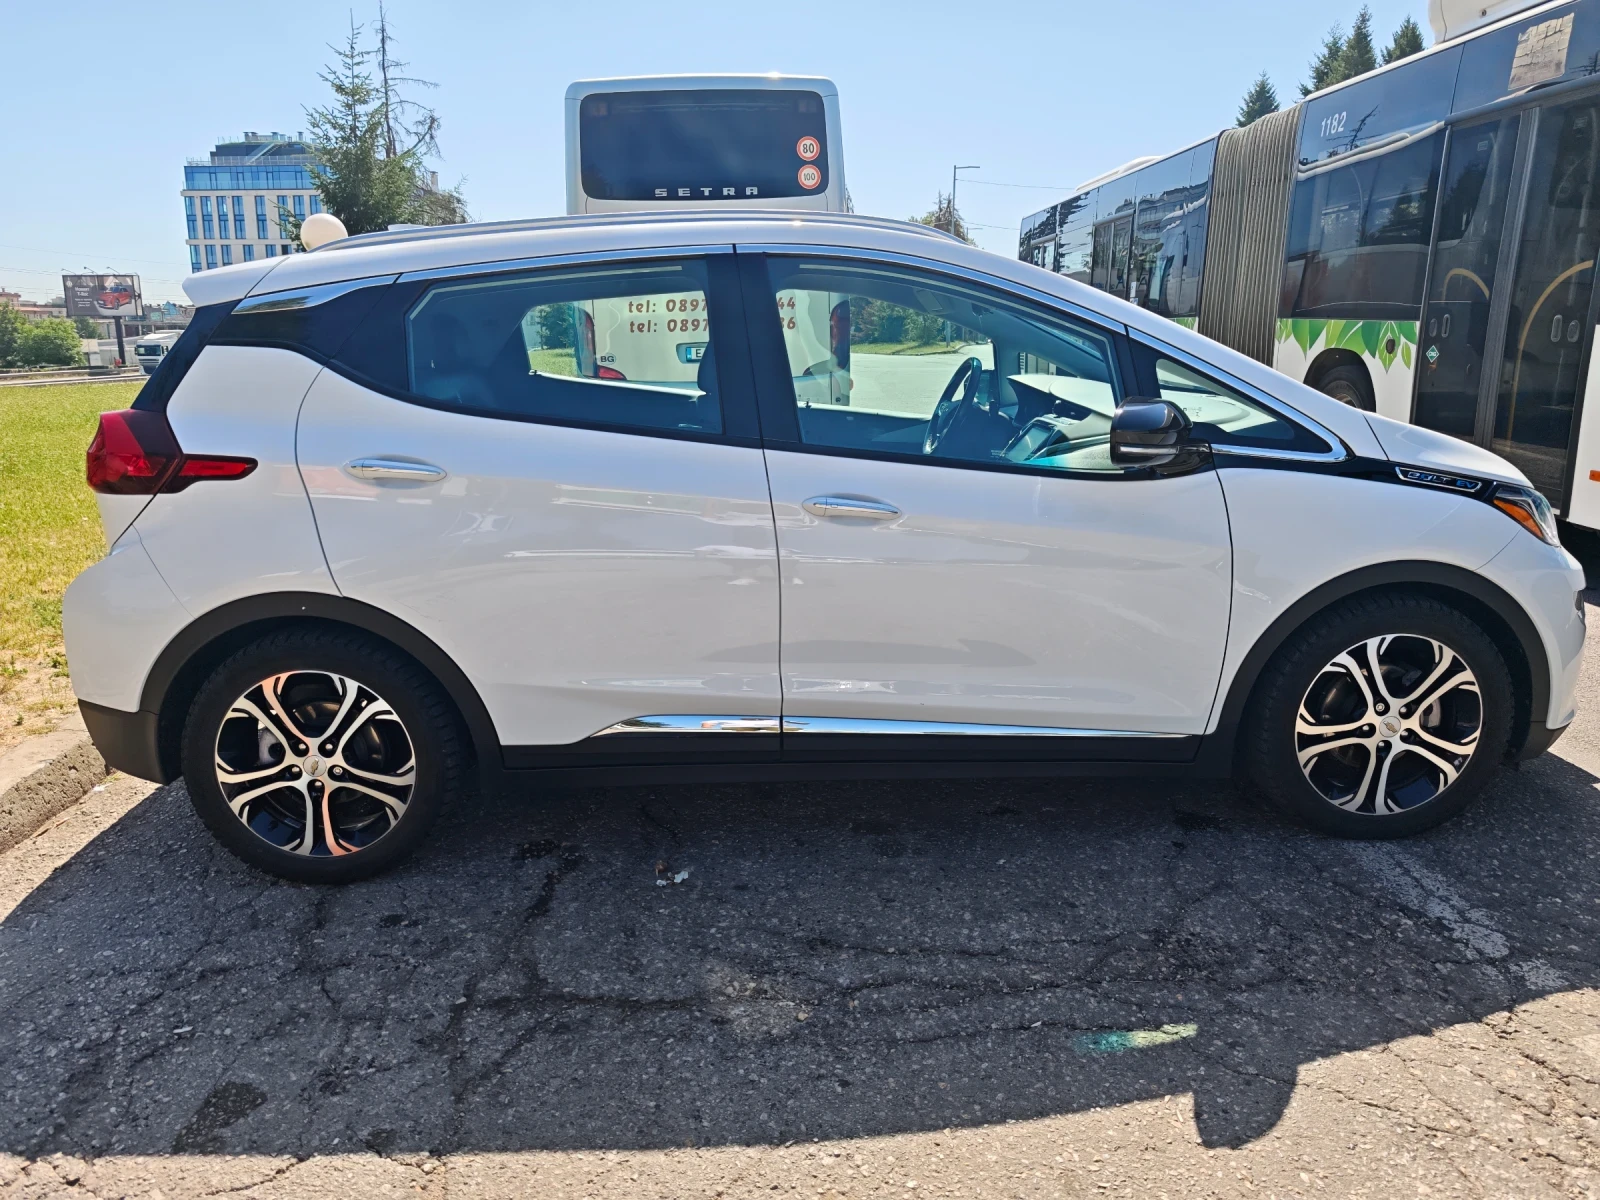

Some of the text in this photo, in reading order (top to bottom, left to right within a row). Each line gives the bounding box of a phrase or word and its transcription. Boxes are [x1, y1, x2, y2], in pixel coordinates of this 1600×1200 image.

[1320, 111, 1347, 138] 1182
[802, 142, 815, 155] 80
[803, 172, 816, 182] 100
[654, 186, 759, 197] SETRA
[628, 299, 656, 313] tel:
[629, 319, 657, 333] tel:
[600, 355, 615, 363] BG
[1455, 478, 1476, 489] EV
